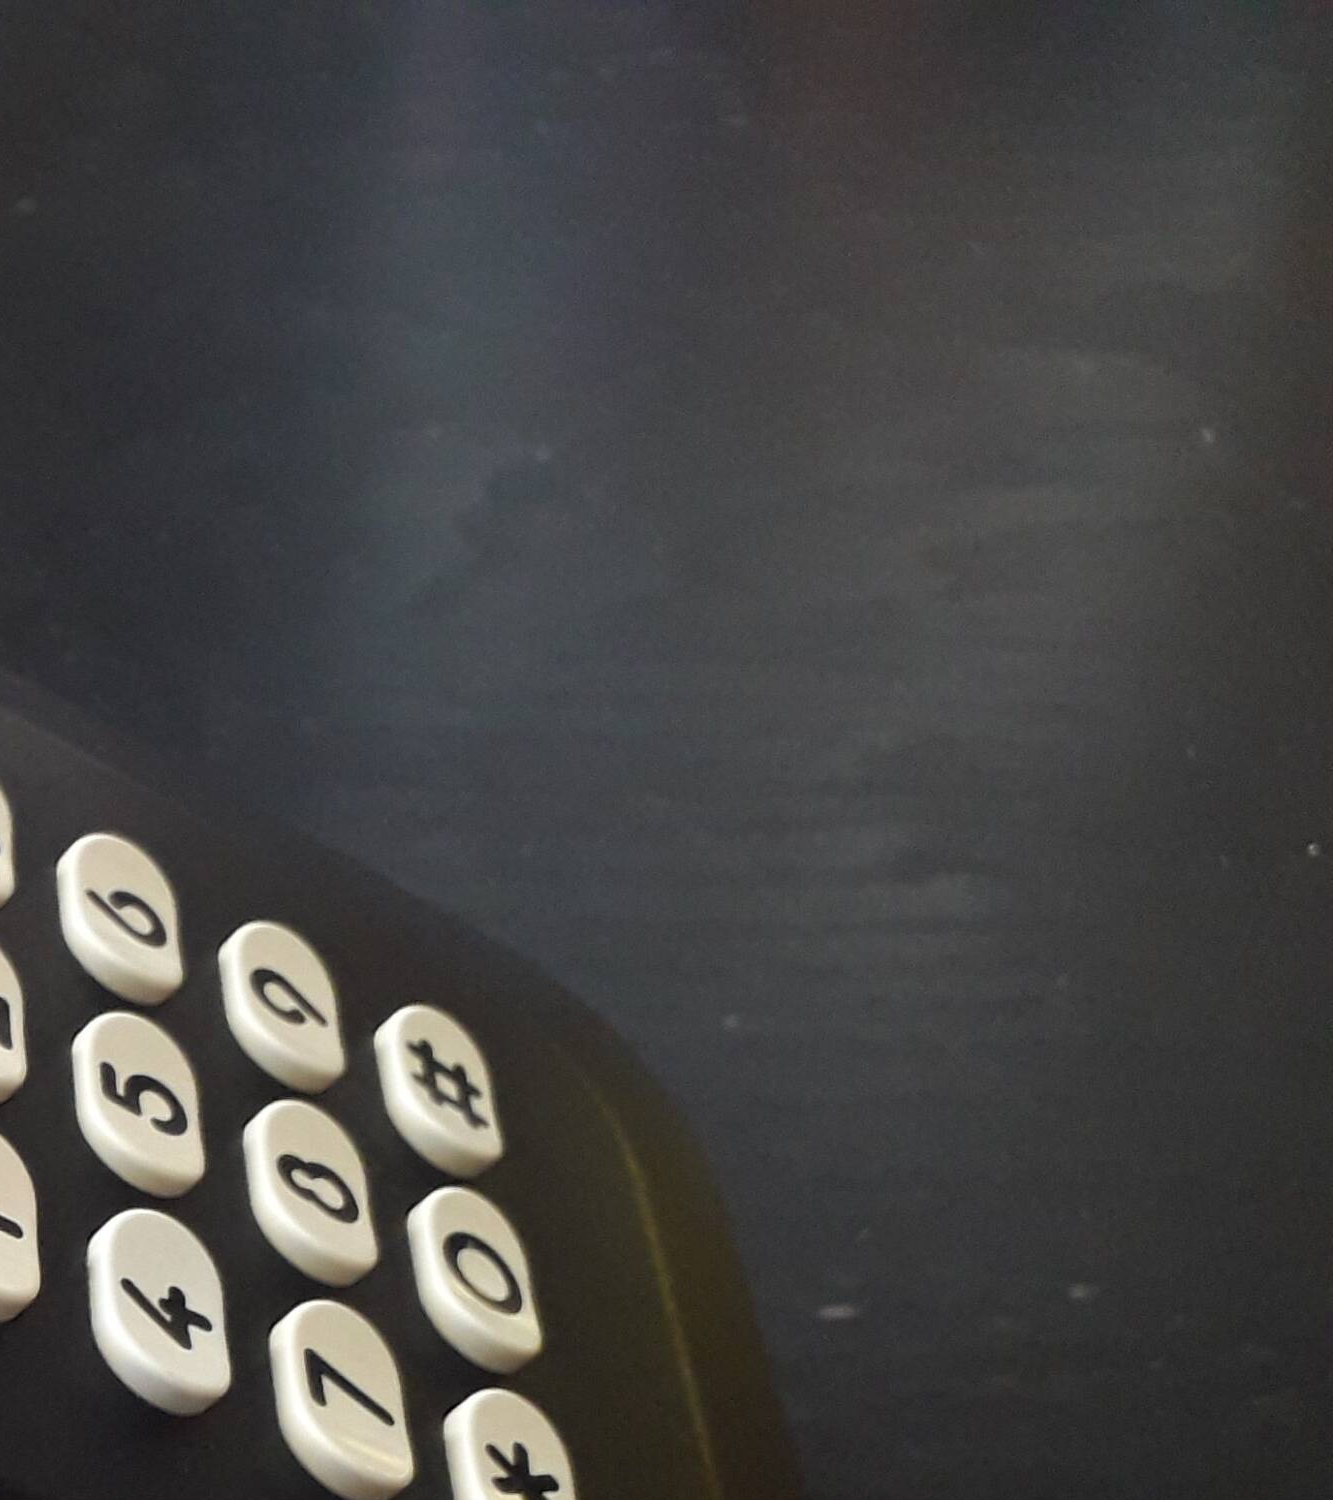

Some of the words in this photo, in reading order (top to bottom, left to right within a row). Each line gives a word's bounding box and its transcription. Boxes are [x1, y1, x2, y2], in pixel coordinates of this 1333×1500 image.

[88, 891, 166, 946] 6
[251, 967, 330, 1025] 9
[101, 1062, 187, 1135] 5
[408, 1038, 489, 1128] #
[278, 1152, 360, 1224] 8
[121, 1279, 212, 1349] 4
[305, 1347, 396, 1426] 7
